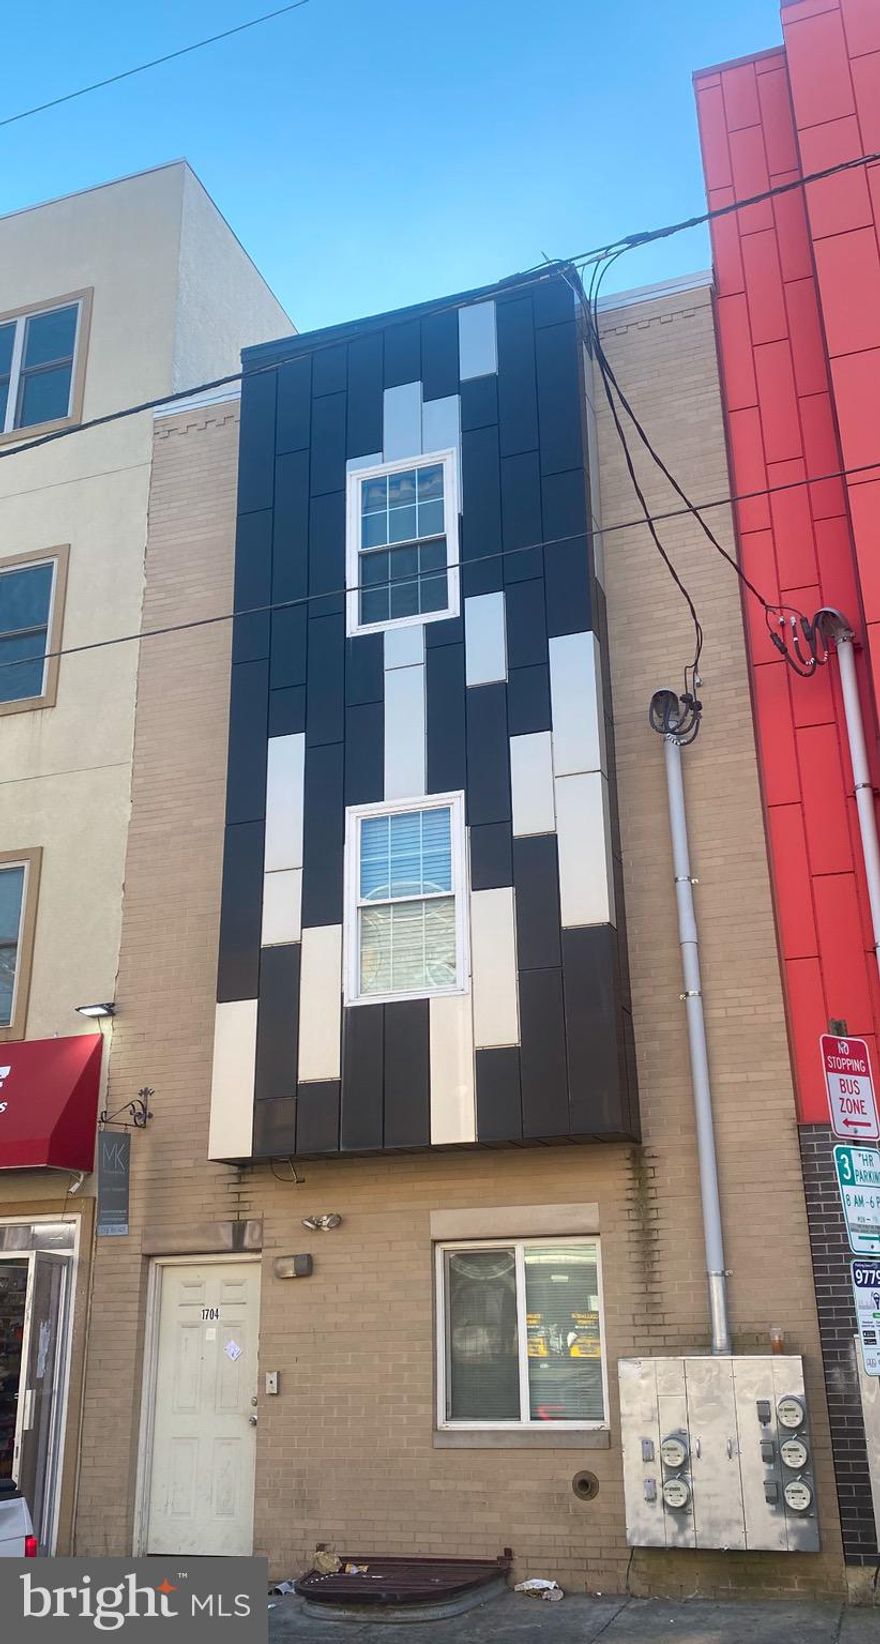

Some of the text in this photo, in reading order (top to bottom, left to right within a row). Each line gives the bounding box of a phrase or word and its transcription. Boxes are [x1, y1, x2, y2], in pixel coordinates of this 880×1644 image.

[838, 1042, 850, 1055] NO
[828, 1056, 866, 1072] STOPPING
[839, 1078, 860, 1095] BUS
[839, 1097, 868, 1115] ZONE
[103, 1143, 125, 1170] MK
[840, 1153, 875, 1180] 3 HR
[845, 1193, 851, 1207] 8
[855, 1268, 880, 1285] 9779
[201, 1308, 220, 1320] 1704
